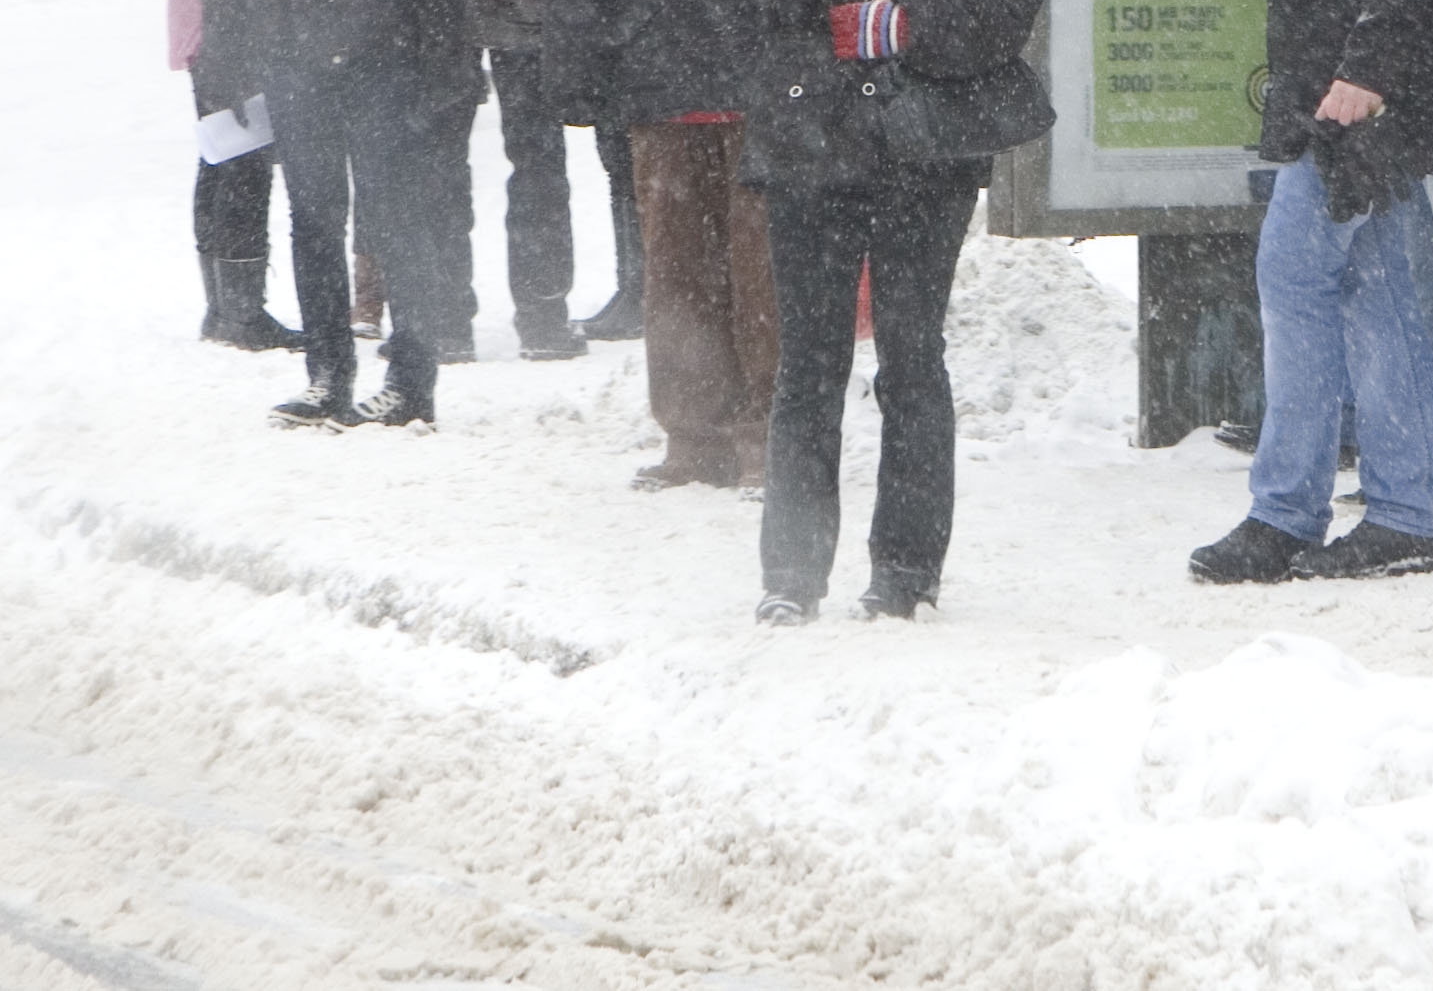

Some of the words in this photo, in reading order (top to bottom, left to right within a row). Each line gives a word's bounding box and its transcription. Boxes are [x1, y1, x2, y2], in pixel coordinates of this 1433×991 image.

[1107, 5, 1153, 32] 150
[1107, 42, 1154, 61] 3000
[1107, 74, 1154, 93] 3000
